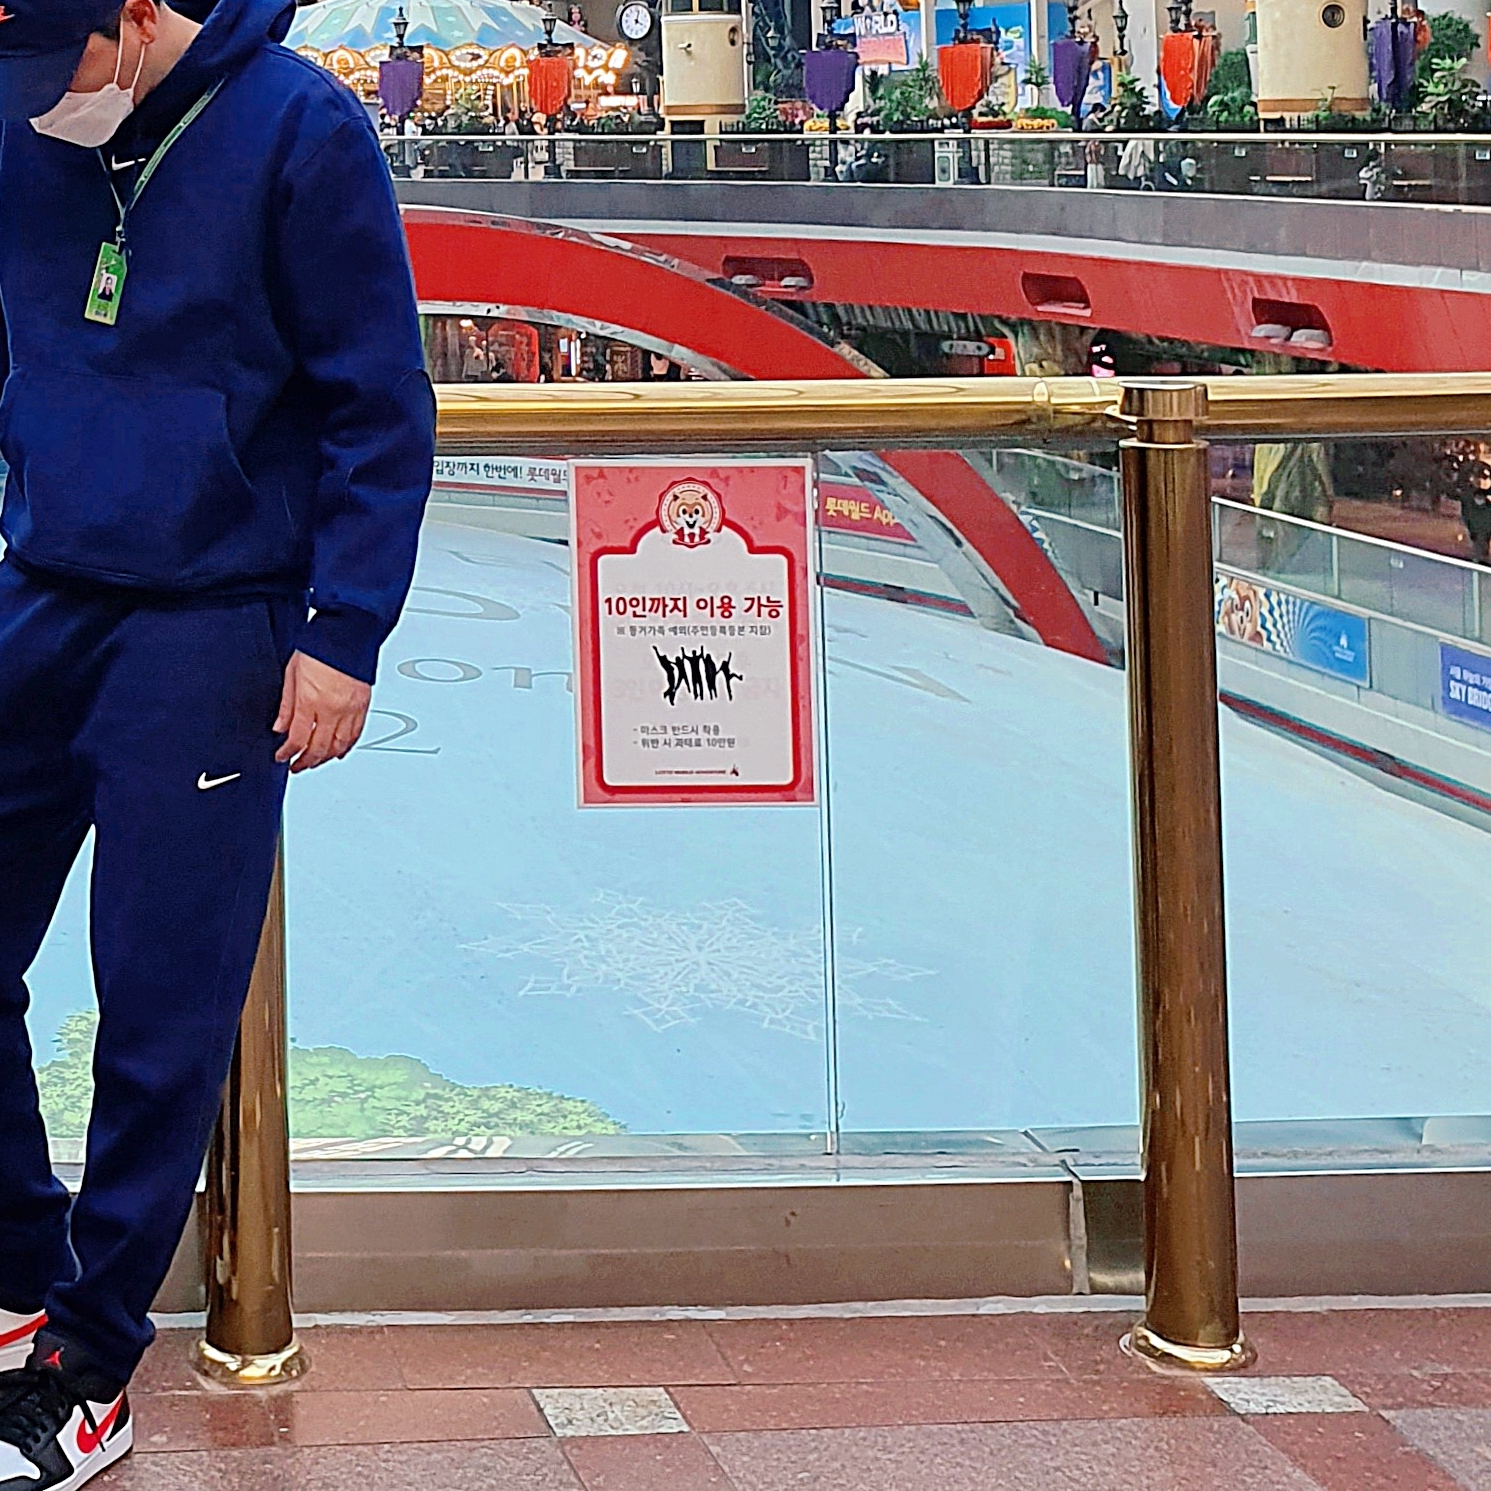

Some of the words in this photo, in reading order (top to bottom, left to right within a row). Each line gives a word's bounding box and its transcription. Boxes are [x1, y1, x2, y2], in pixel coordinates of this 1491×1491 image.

[483, 463, 523, 480] 한번에!
[825, 497, 872, 520] 롯데월드
[604, 596, 688, 619] 10인까지
[696, 595, 736, 619] 이용
[743, 595, 784, 619] 가능
[1449, 679, 1467, 702] SKY
[640, 725, 668, 735] 마스크
[671, 725, 699, 736] 반드시
[641, 738, 659, 749] 위반
[662, 738, 671, 748] 시
[706, 738, 736, 748] 10만원
